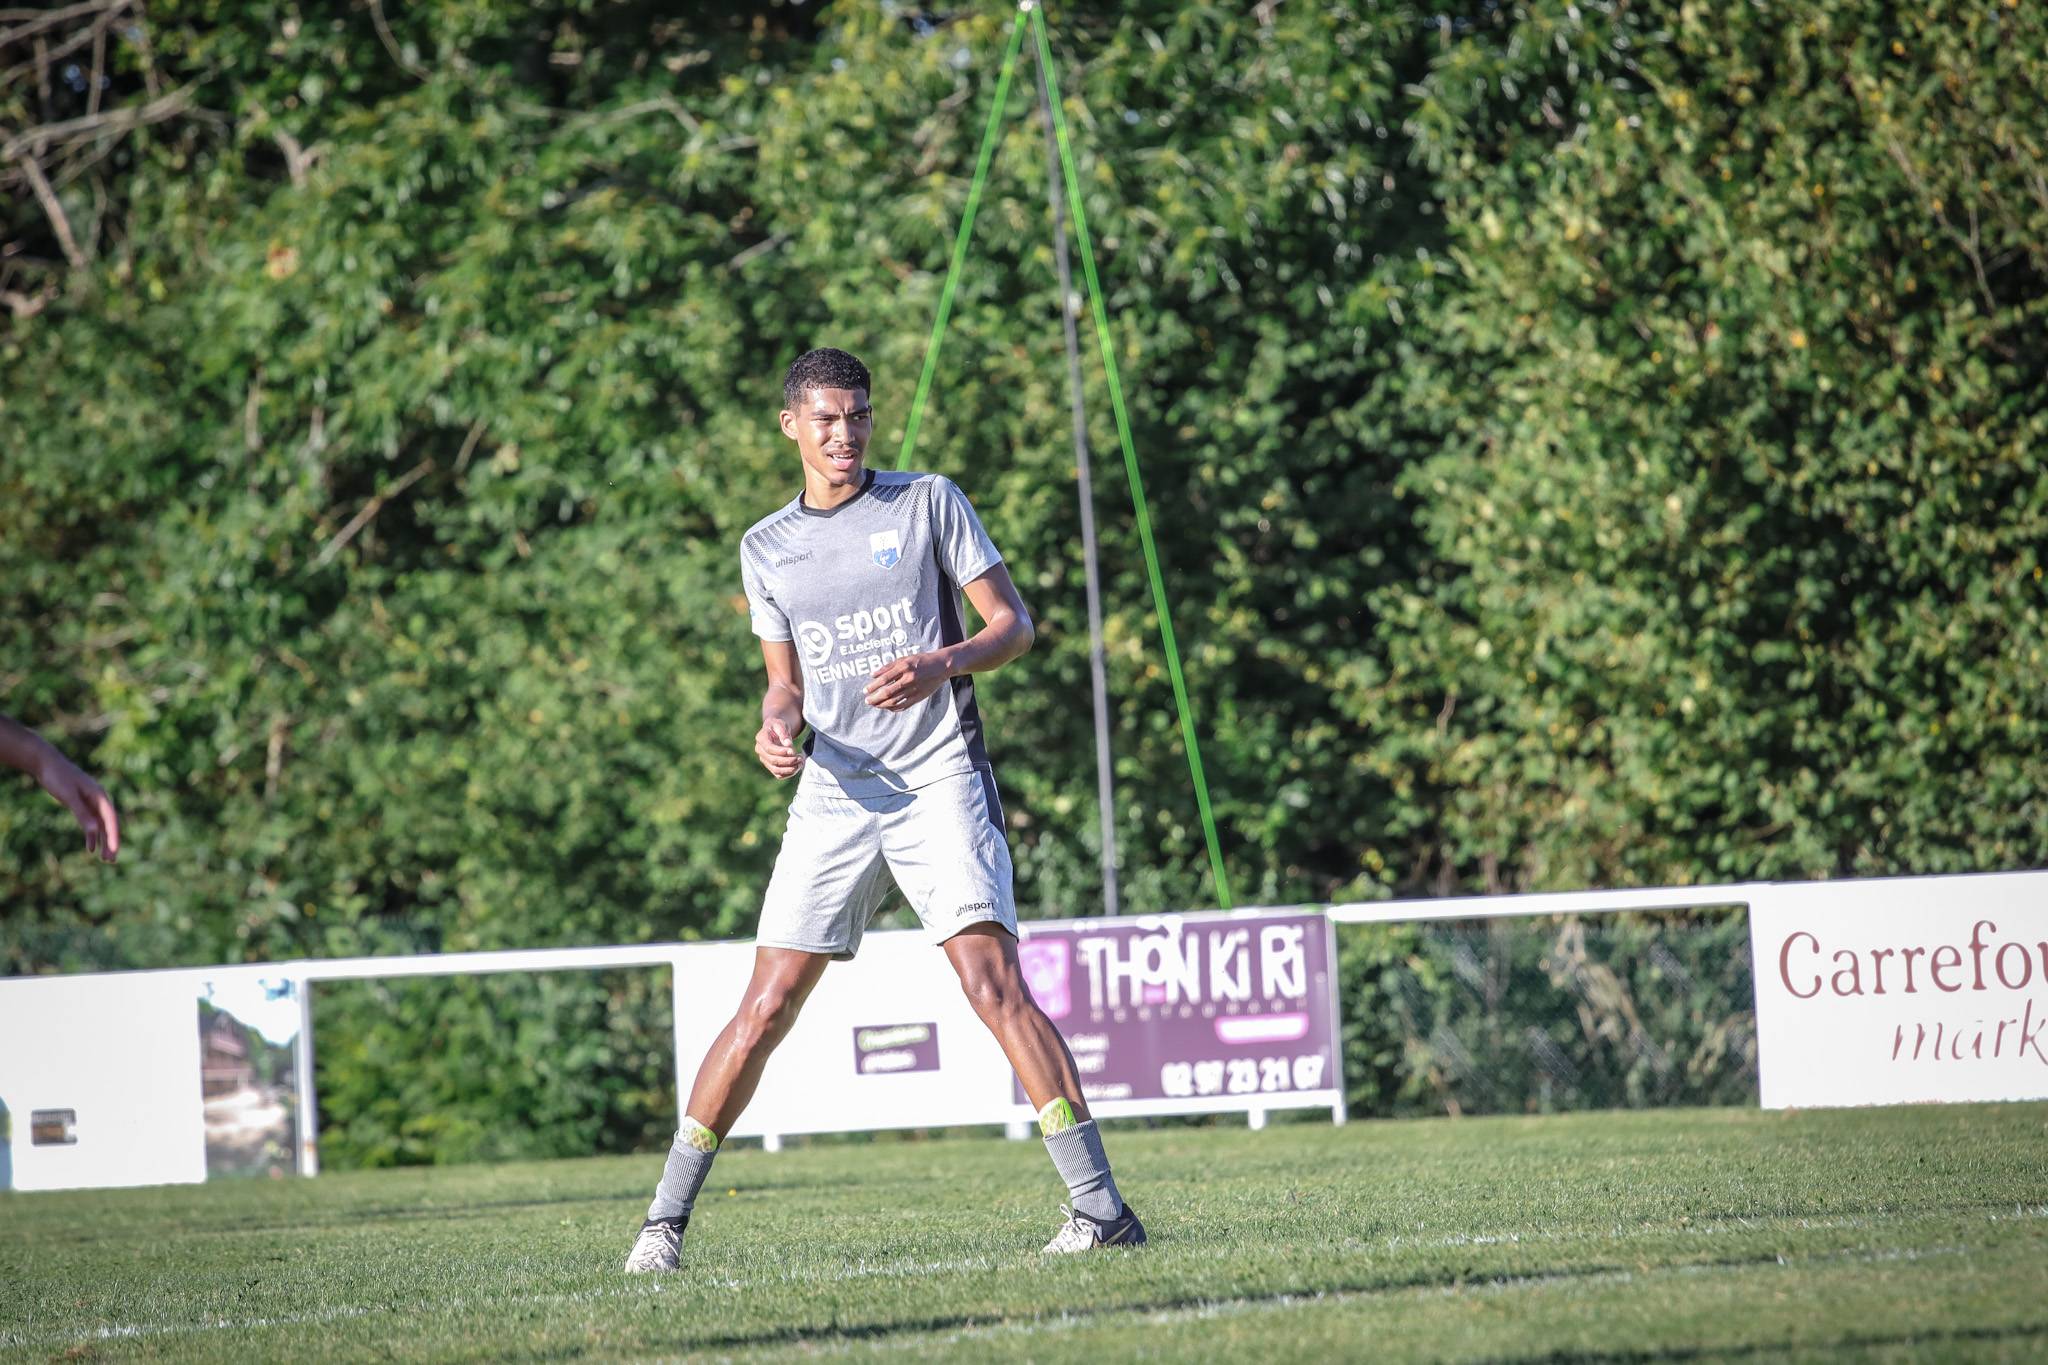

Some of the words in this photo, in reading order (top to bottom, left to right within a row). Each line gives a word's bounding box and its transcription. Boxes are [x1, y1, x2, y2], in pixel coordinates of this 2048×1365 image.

[775, 550, 813, 568] uhlsport
[835, 597, 916, 641] sport
[955, 901, 995, 917] uhlsport
